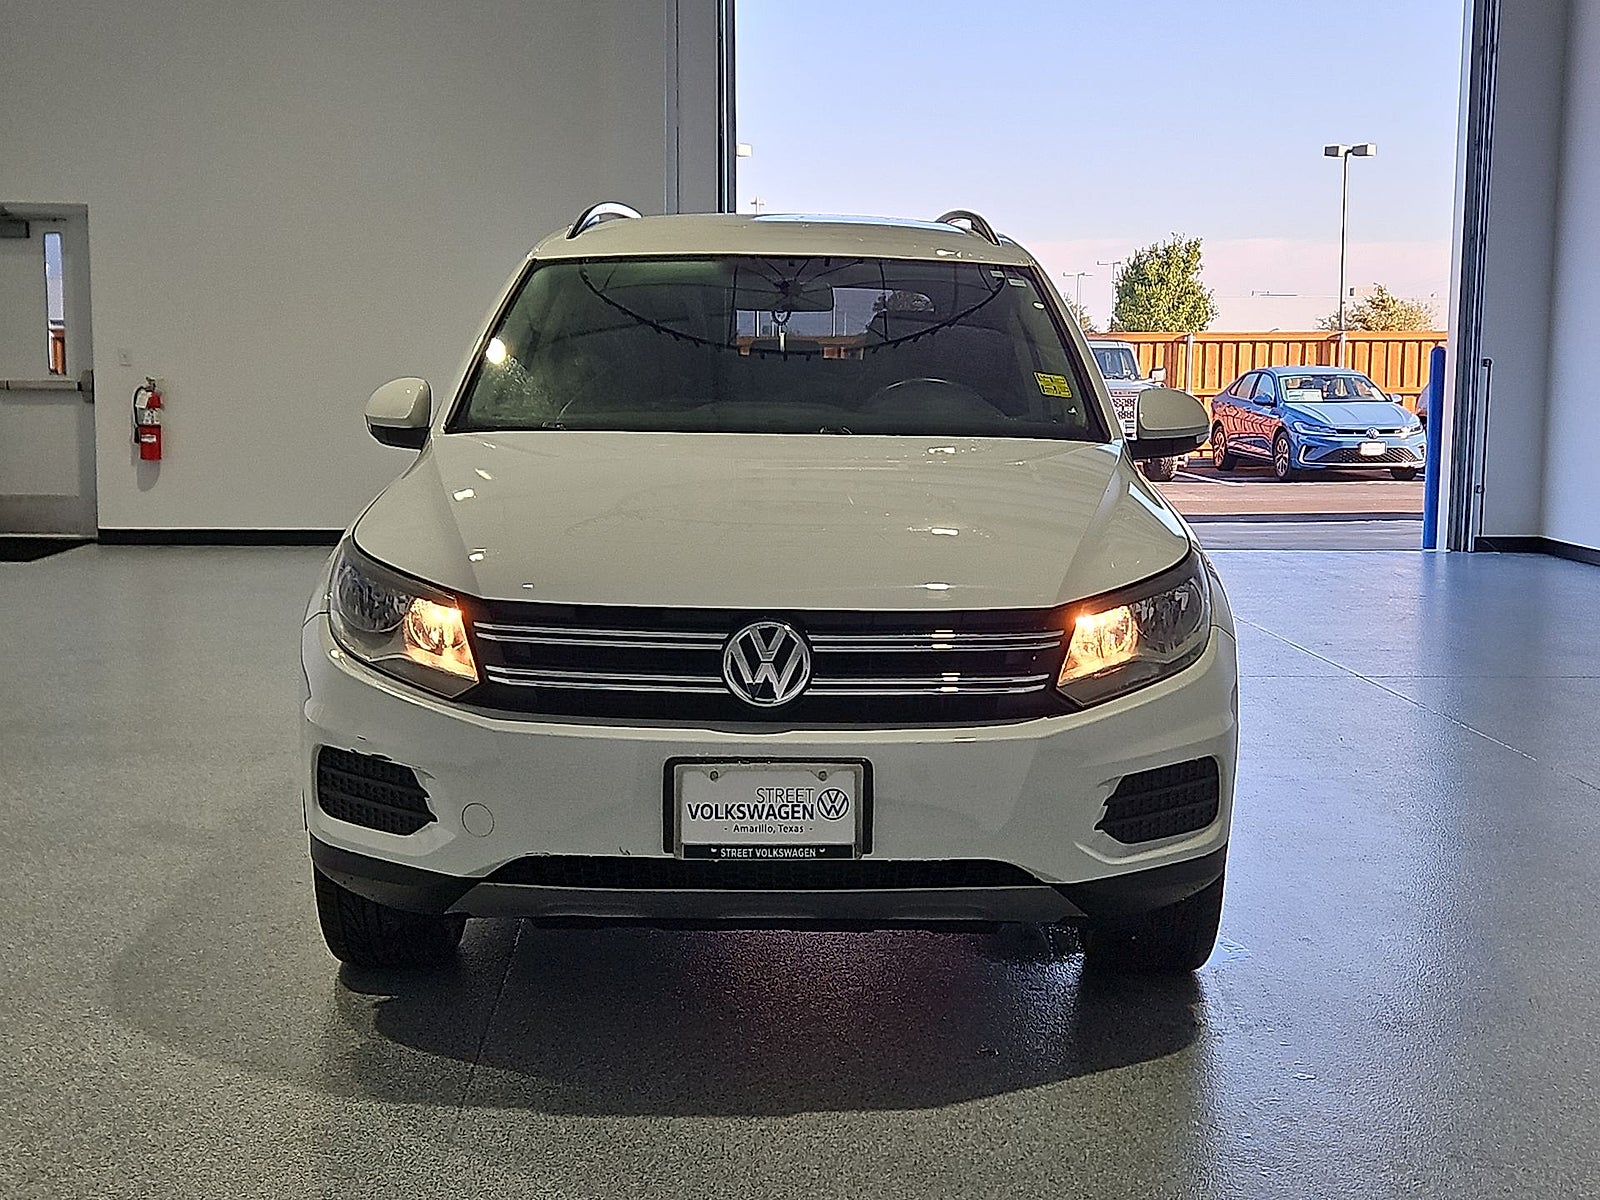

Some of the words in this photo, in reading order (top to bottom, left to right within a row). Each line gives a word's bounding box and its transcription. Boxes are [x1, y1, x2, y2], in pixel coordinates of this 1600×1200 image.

[756, 788, 815, 803] STREET
[687, 803, 815, 820] VOLKSWAGEN
[733, 824, 776, 834] Amarillo,
[778, 824, 804, 833] Texas
[720, 848, 753, 858] STREET
[756, 848, 816, 858] VOLKSWAGEN
